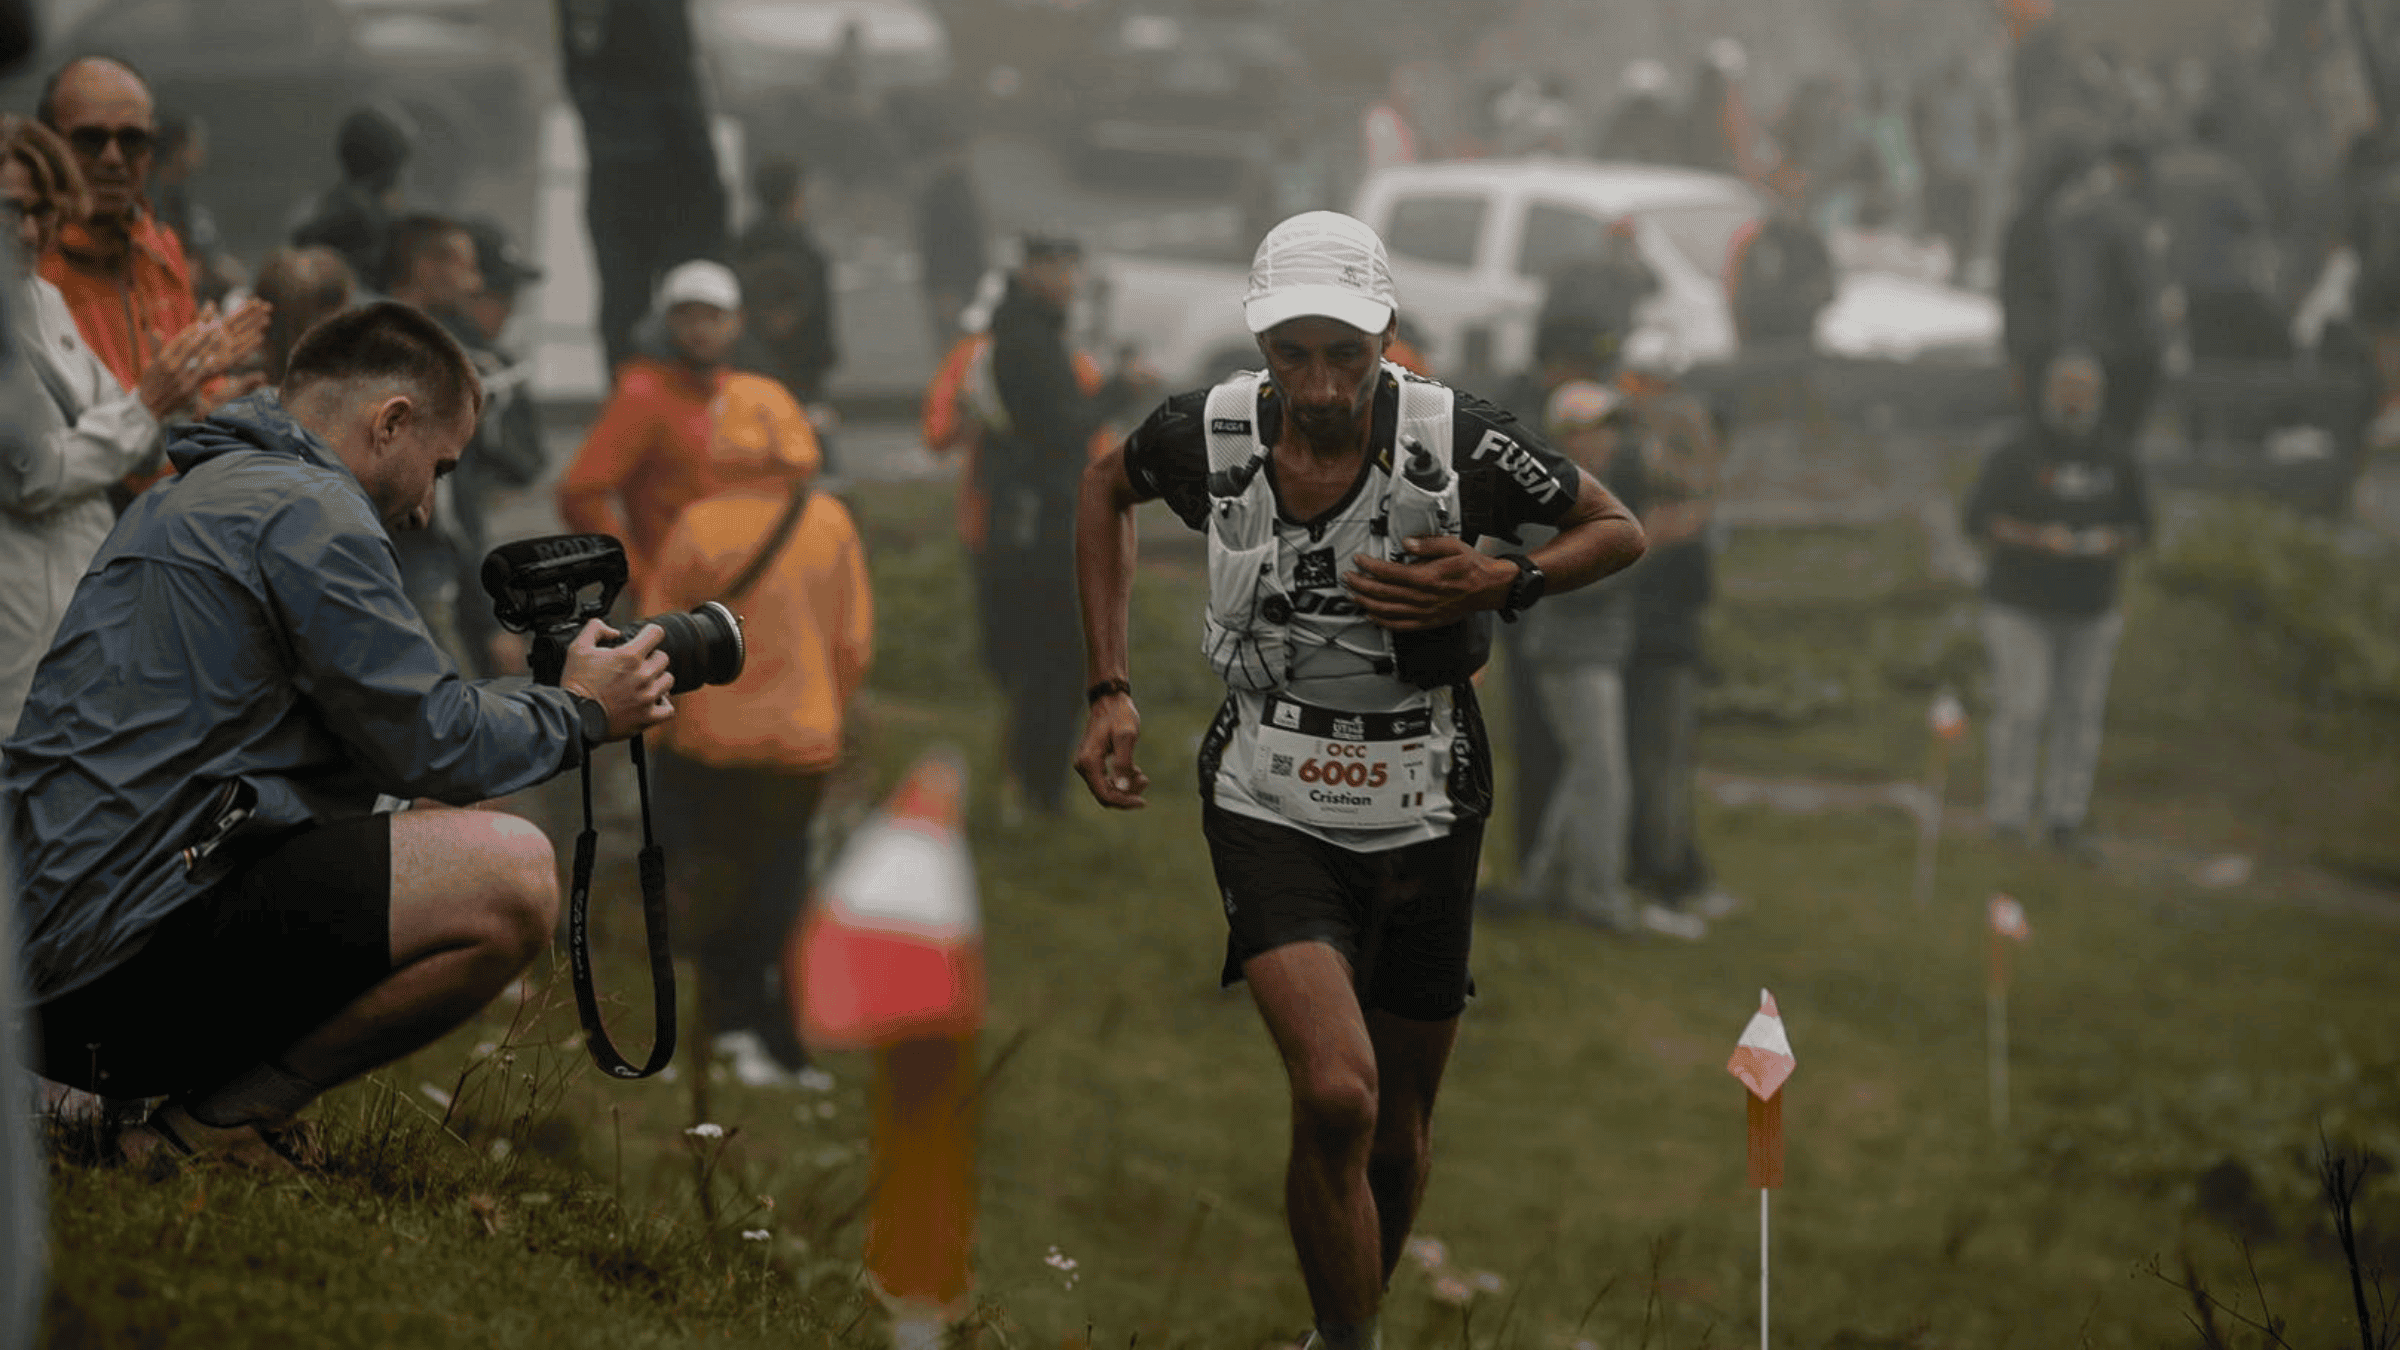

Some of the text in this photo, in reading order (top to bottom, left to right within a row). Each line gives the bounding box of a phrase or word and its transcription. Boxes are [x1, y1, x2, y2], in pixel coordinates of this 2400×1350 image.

[1470, 428, 1562, 505] FUGA
[1326, 742, 1368, 759] OCC
[1297, 757, 1389, 788] 6005
[1309, 789, 1373, 807] Cristian
